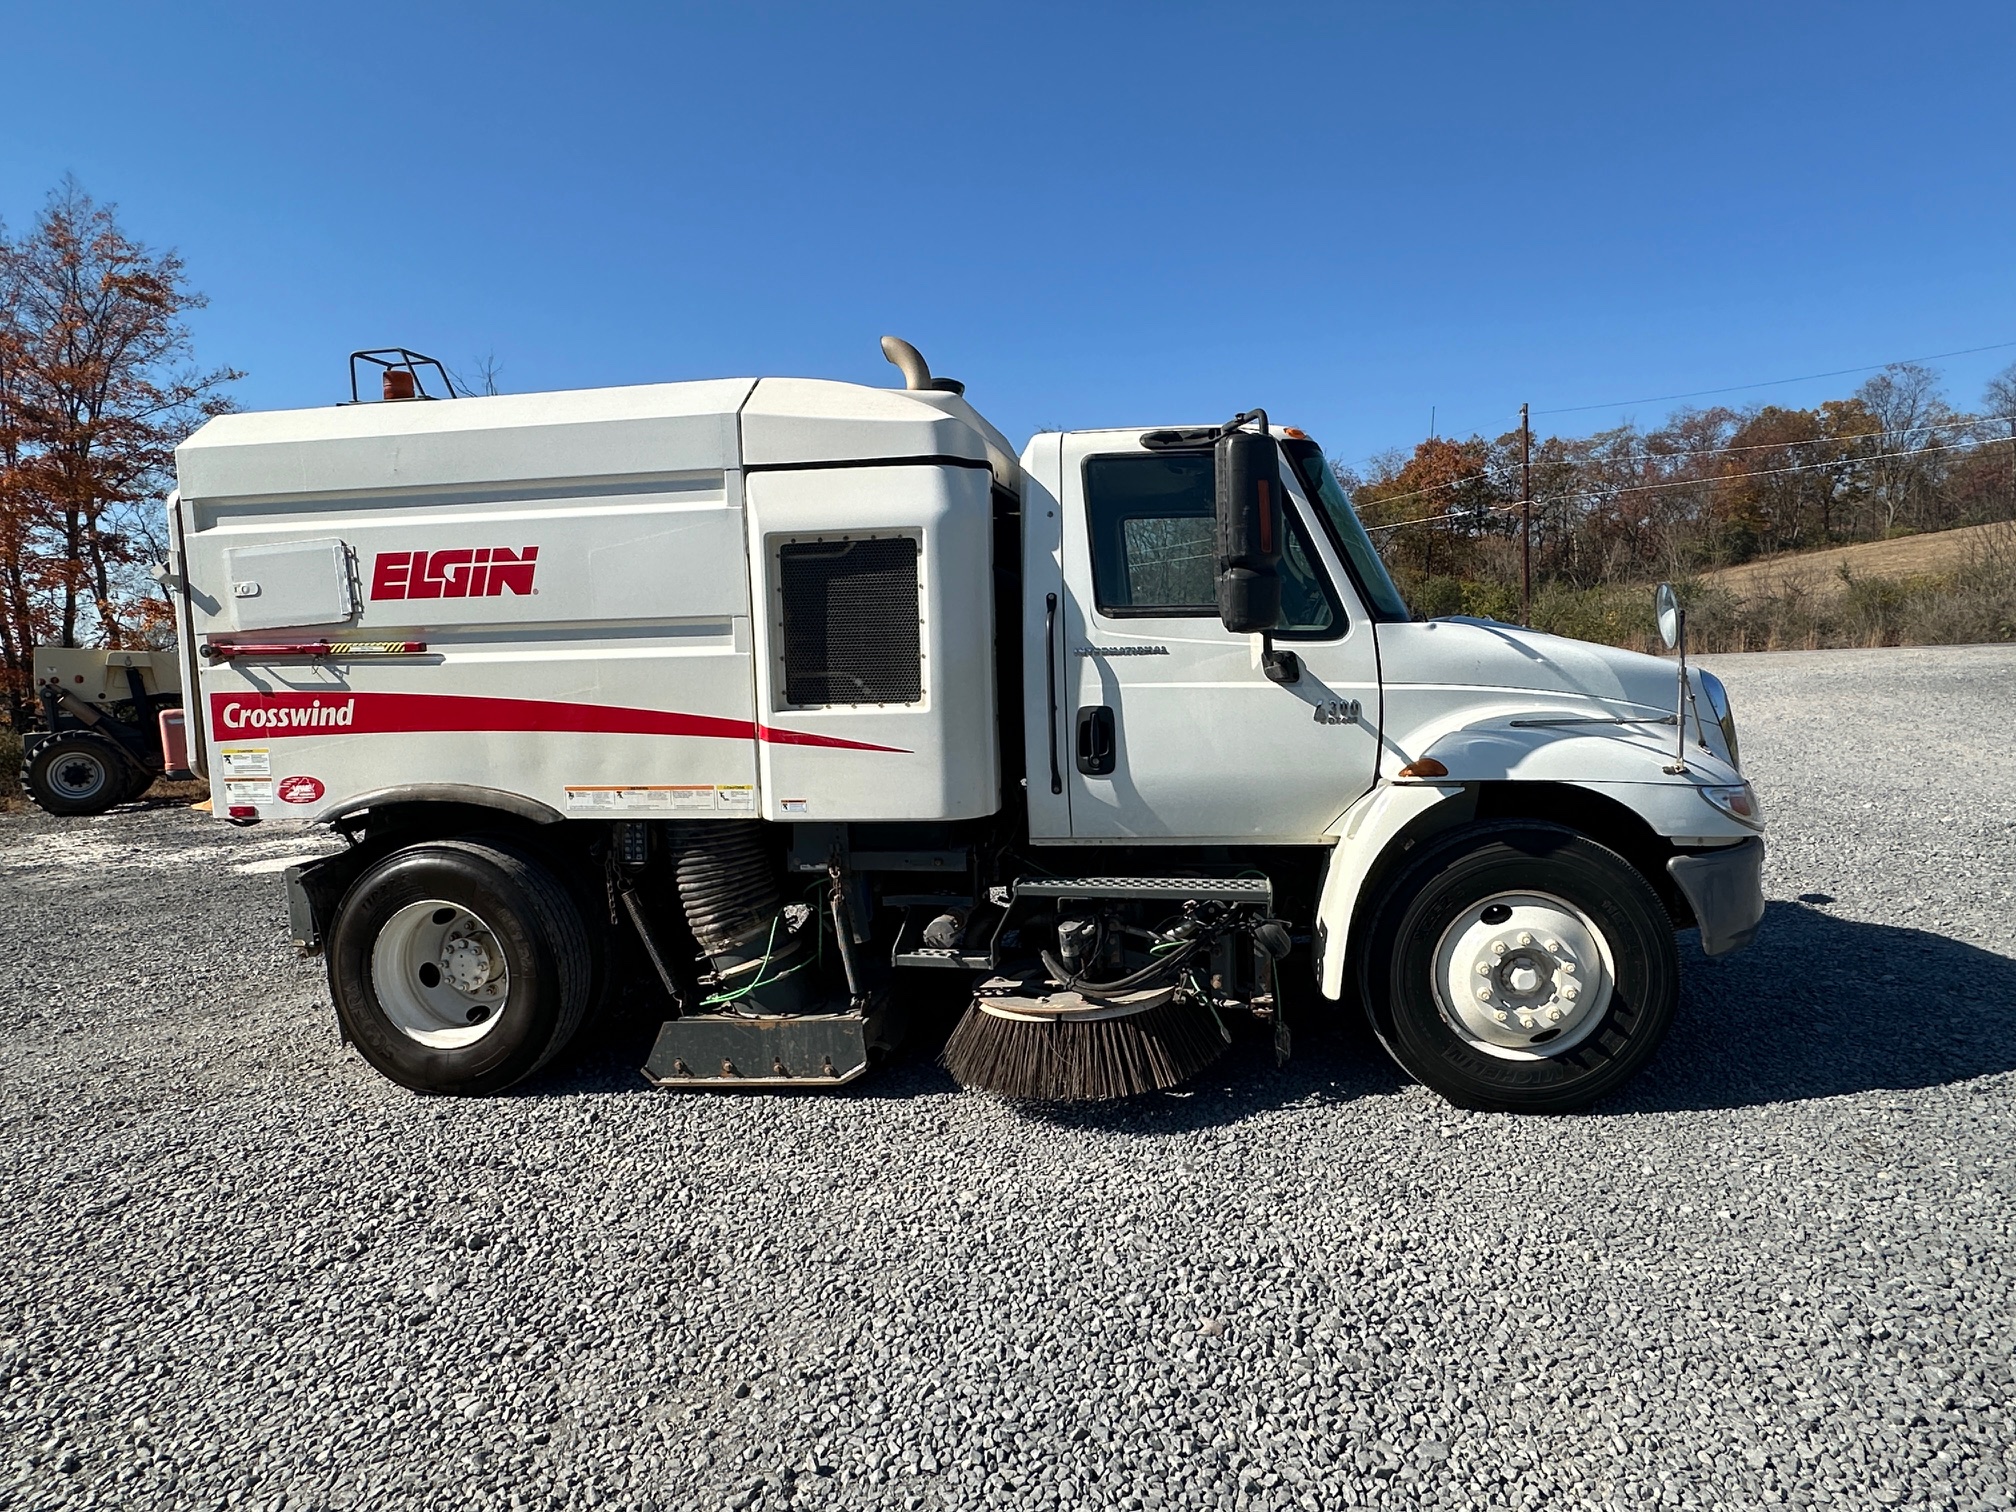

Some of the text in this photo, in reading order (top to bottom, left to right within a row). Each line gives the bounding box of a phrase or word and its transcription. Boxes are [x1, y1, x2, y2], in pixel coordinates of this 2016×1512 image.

[370, 546, 539, 600] ELGIN
[223, 698, 355, 728] Crosswind
[1446, 1049, 1564, 1084] MICHELIN
